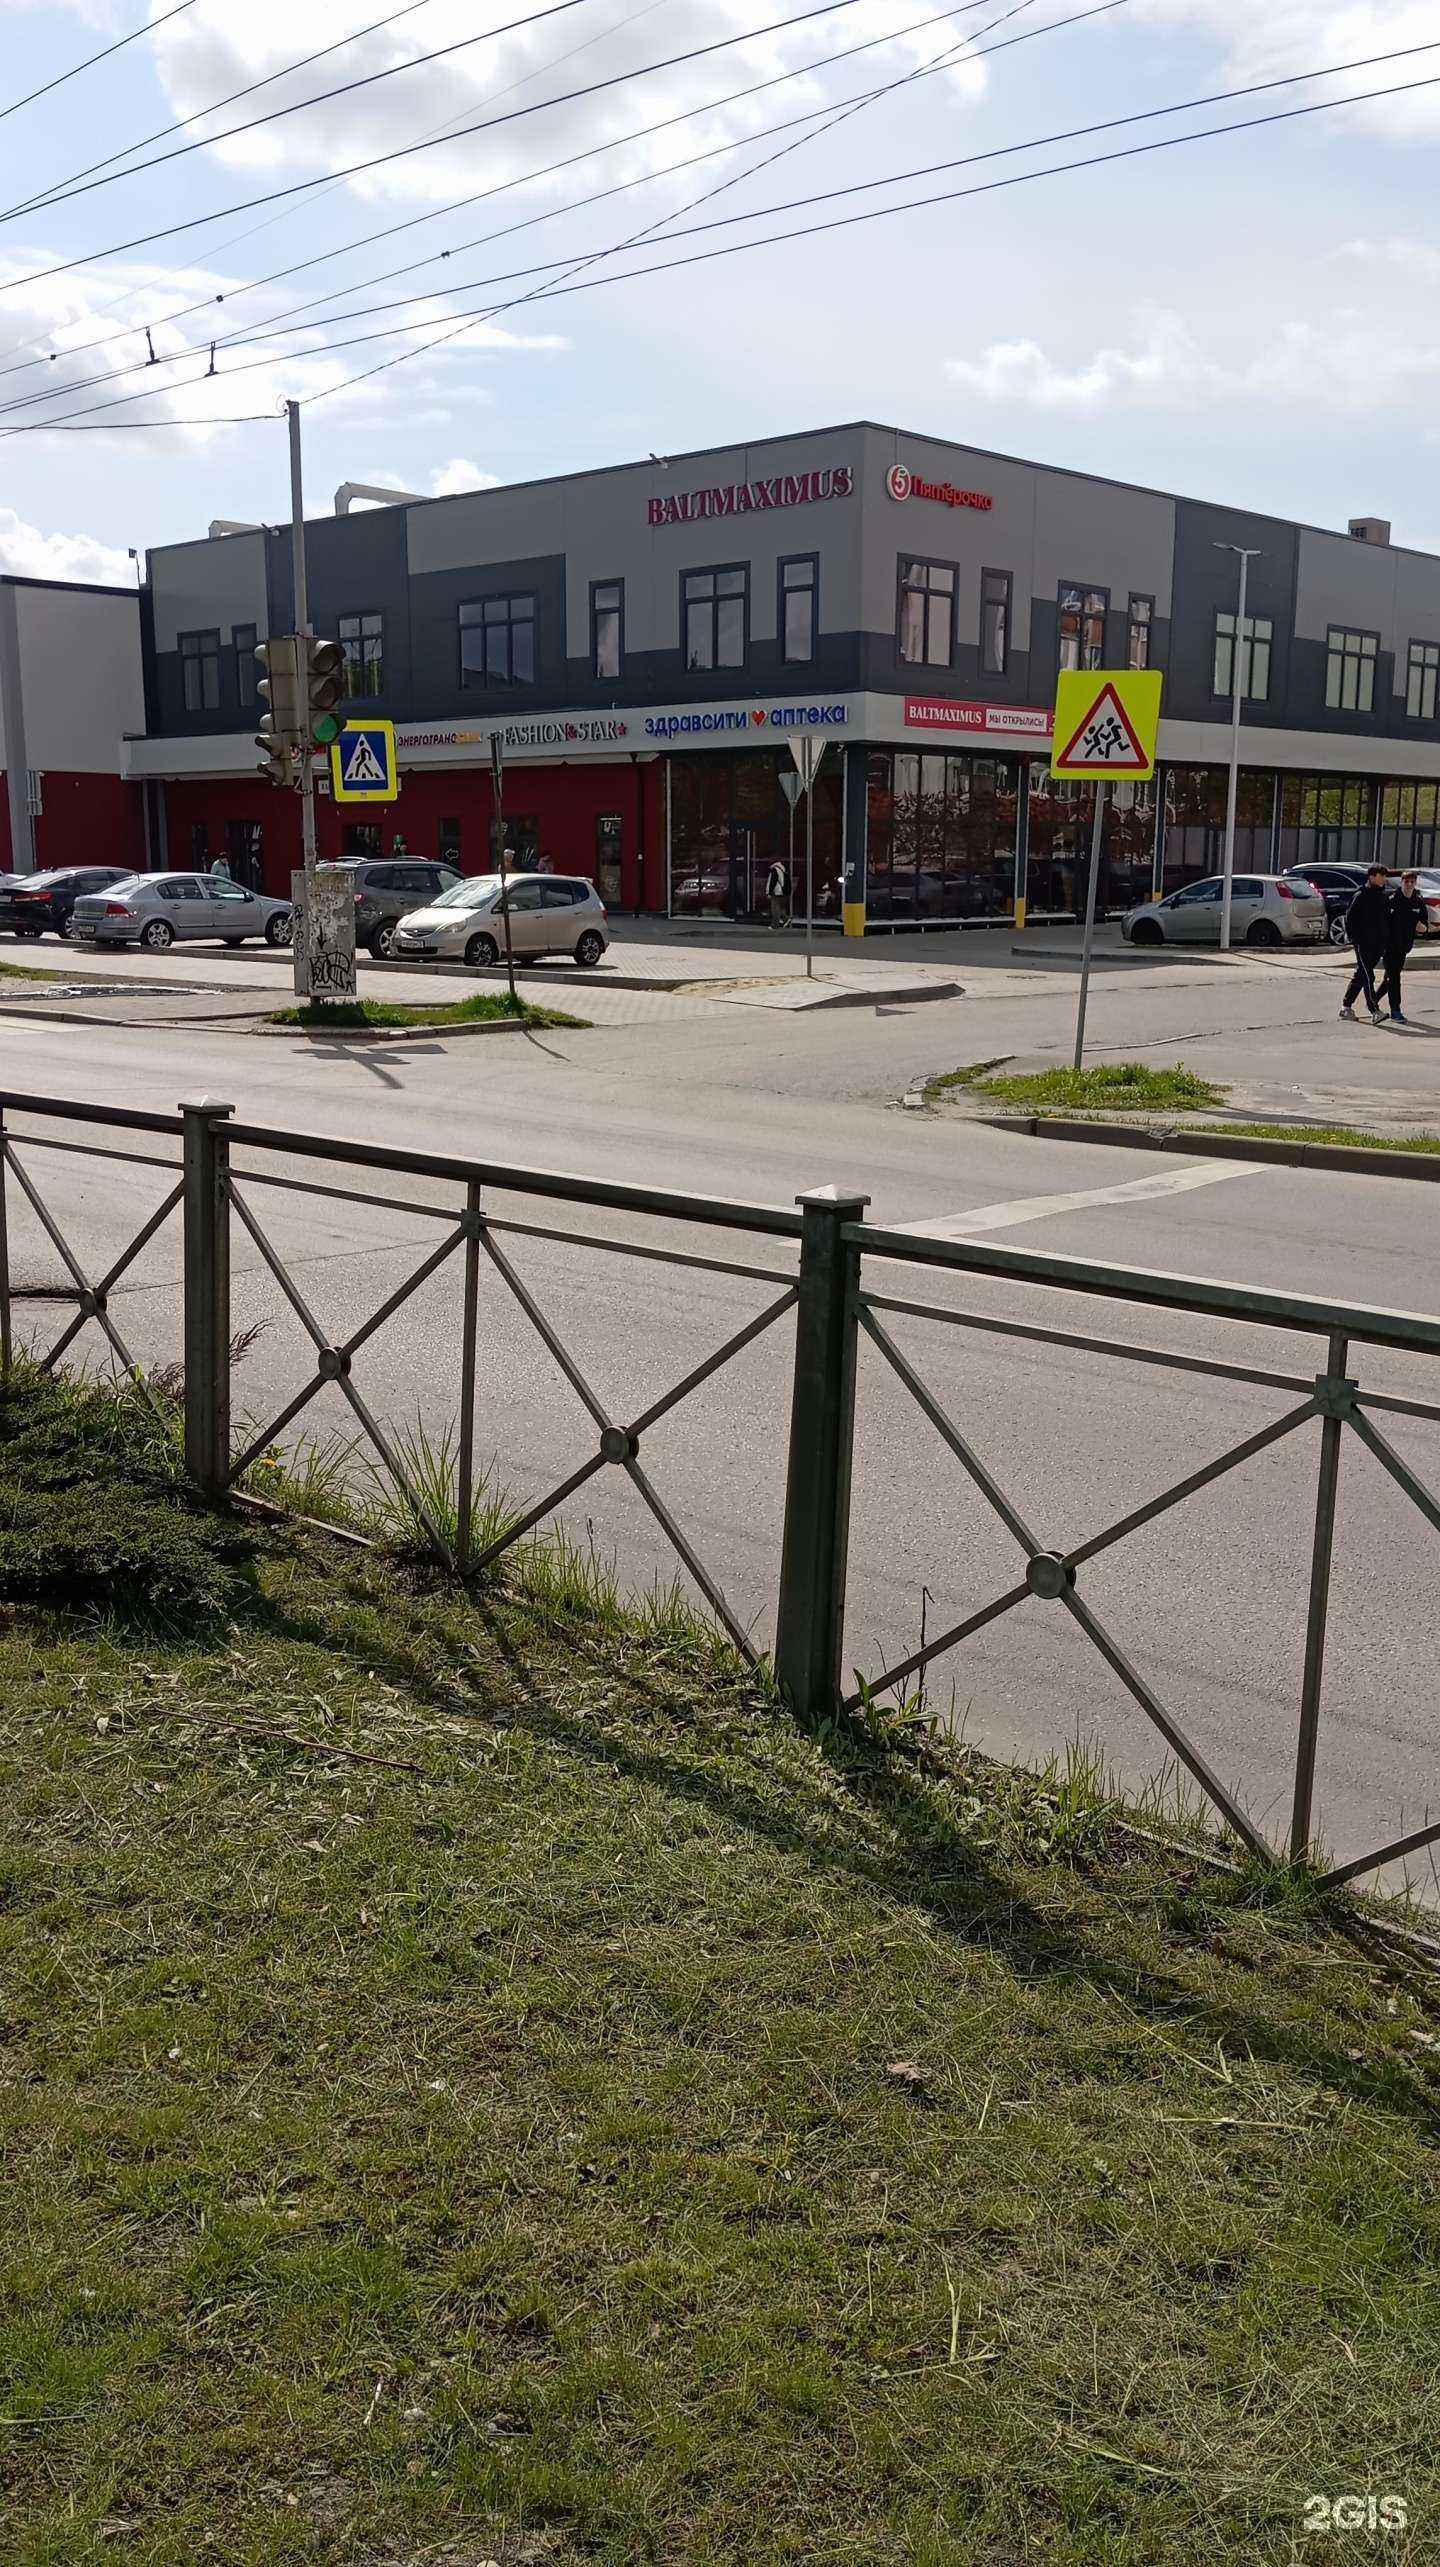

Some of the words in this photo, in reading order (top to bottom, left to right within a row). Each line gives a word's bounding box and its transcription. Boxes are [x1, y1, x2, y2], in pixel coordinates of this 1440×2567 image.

[648, 466, 853, 527] BALTMAXIMUS
[644, 710, 748, 739] здравсити
[770, 704, 848, 727] аптека
[909, 705, 982, 724] BALTMAXIMUS
